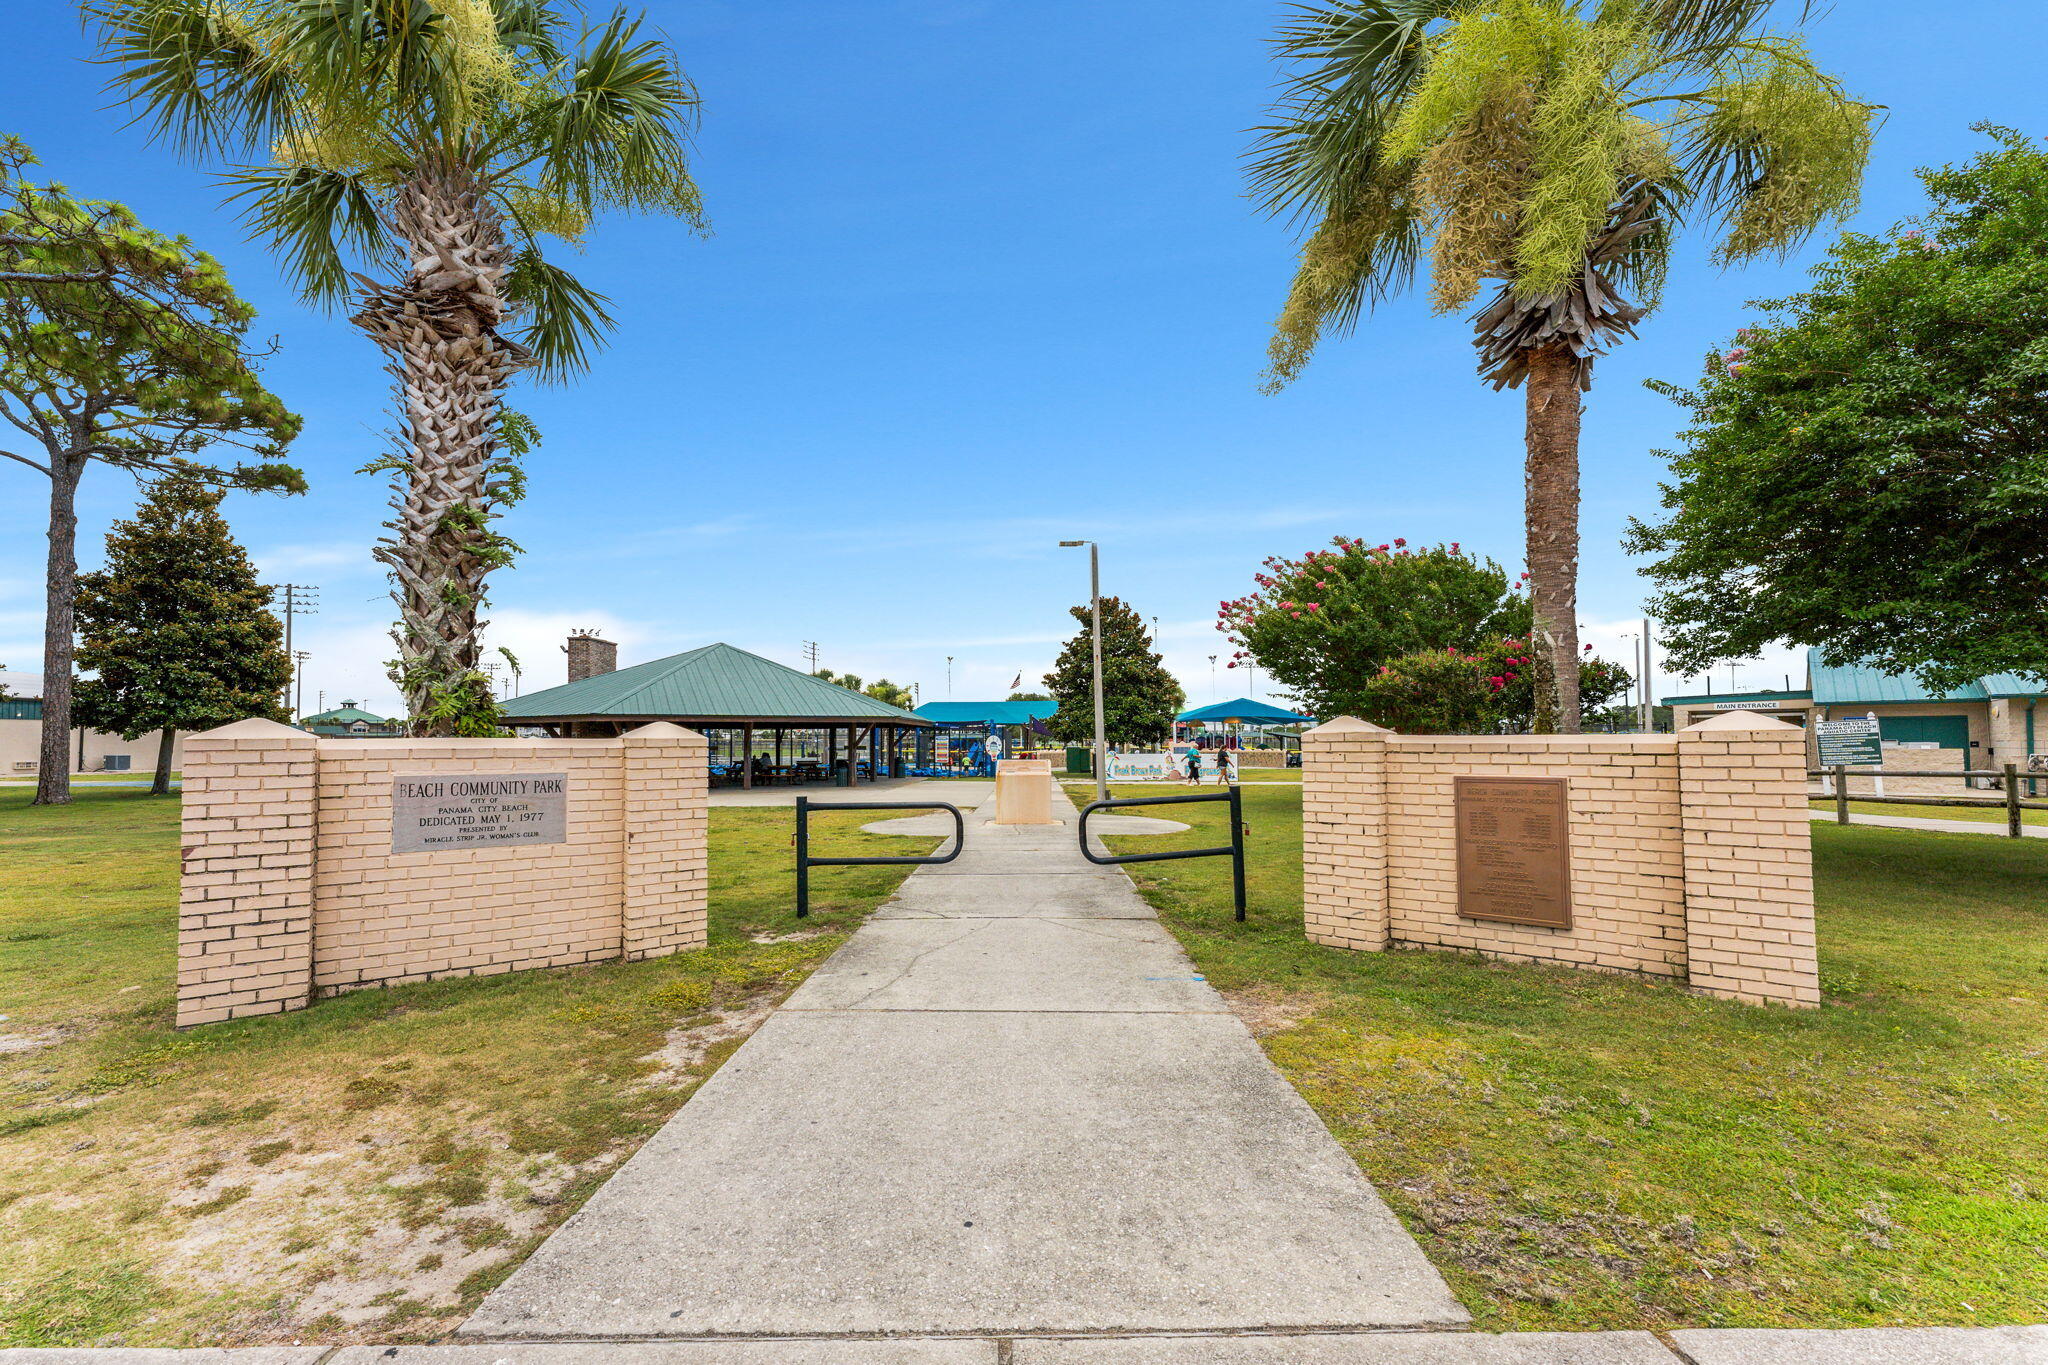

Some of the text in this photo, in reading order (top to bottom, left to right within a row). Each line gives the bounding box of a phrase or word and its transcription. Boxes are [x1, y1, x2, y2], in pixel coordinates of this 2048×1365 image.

[400, 780, 562, 798] BEACH COMMUNITY PARK
[419, 816, 475, 827] DEDICATED
[480, 815, 501, 824] MAY
[519, 813, 544, 822] 1977
